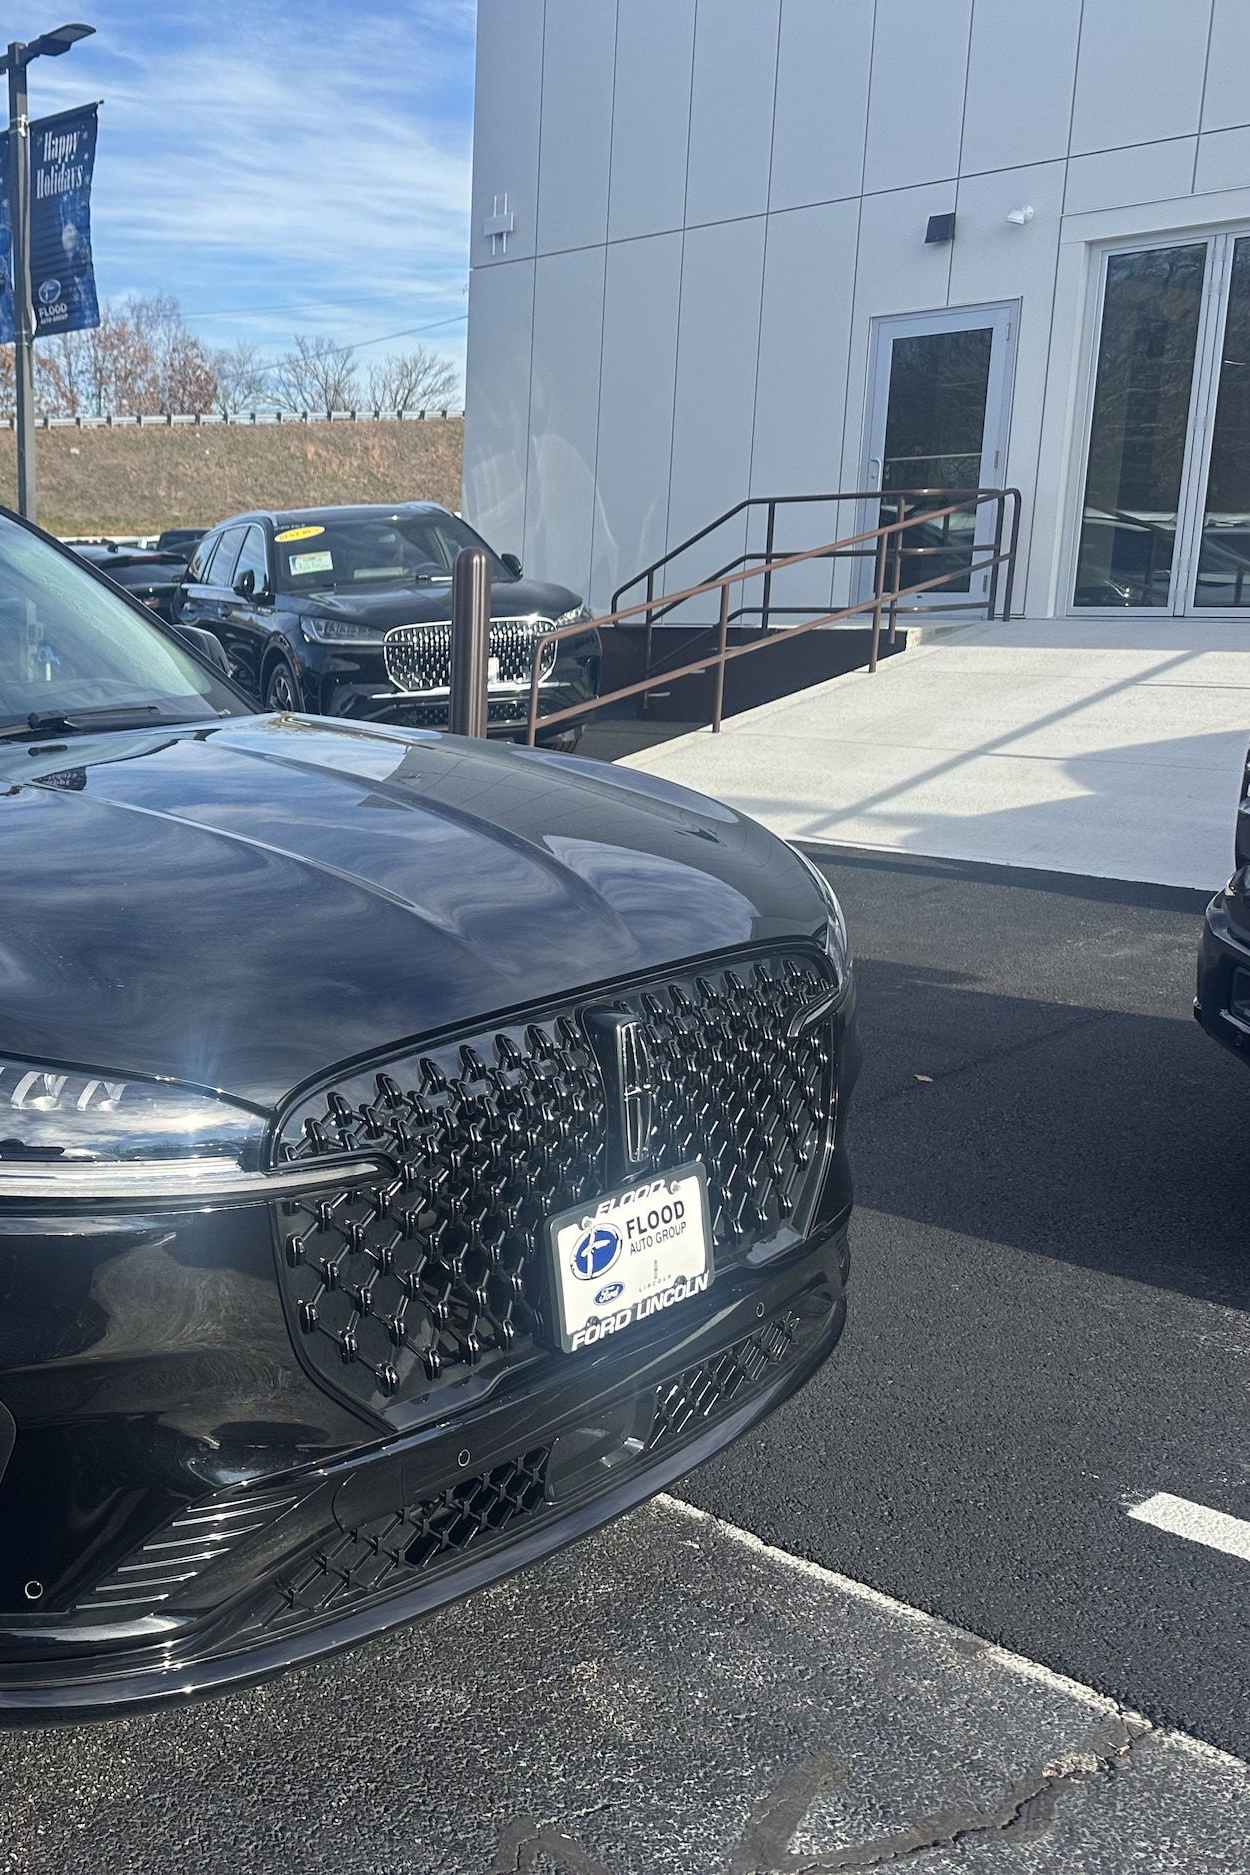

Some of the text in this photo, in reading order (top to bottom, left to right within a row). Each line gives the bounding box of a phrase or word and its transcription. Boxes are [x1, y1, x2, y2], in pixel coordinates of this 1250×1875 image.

[43, 131, 80, 163] Happy
[36, 164, 83, 199] Holidays
[38, 303, 68, 318] FLOOD
[596, 1178, 667, 1215] FLOOD
[626, 1200, 685, 1239] FLOOD
[630, 1221, 687, 1256] AUTO GROUP
[598, 1285, 621, 1303] Ford
[638, 1274, 672, 1293] LINCOLN
[571, 1270, 710, 1352] FORD LINCOLN
